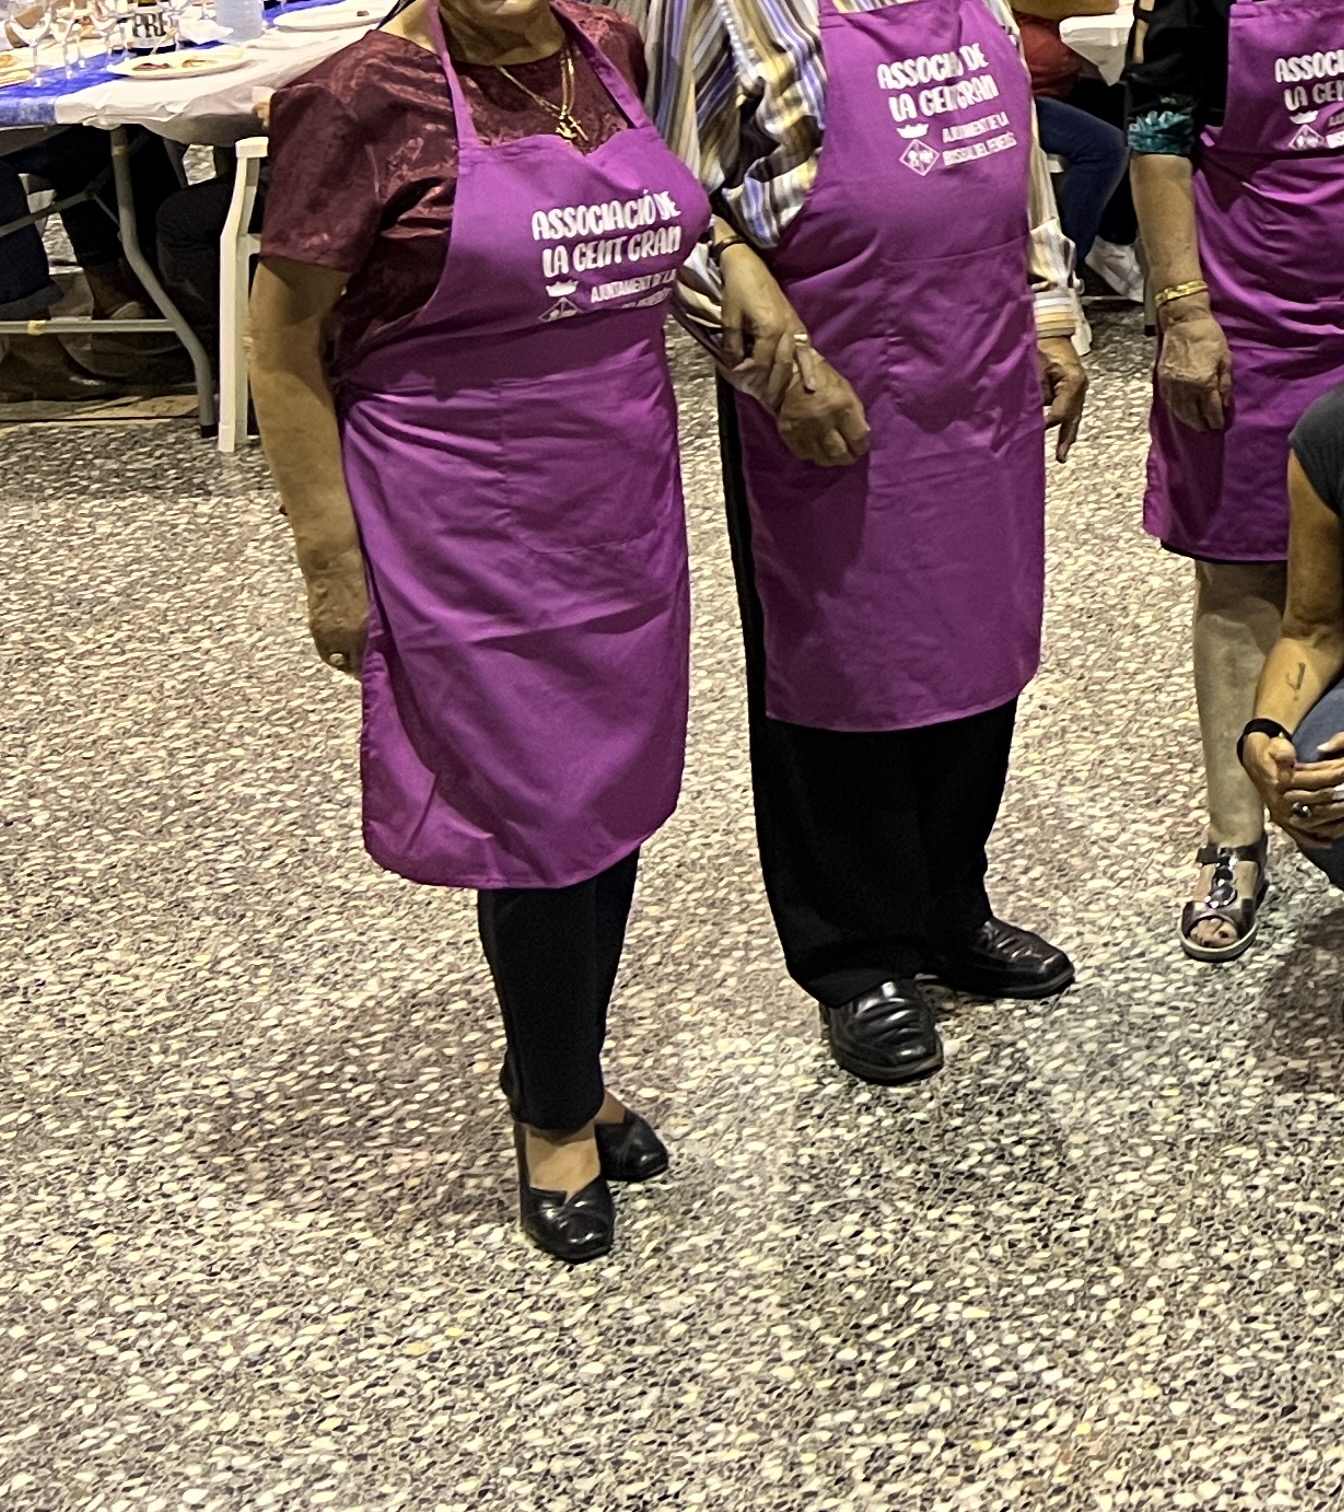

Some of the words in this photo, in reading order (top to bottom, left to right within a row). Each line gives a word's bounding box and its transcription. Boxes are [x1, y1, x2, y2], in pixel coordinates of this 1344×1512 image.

[958, 43, 989, 71] DE
[888, 93, 918, 122] LA
[1284, 86, 1309, 112] LA
[531, 189, 656, 241] ASSOCIACIÓ
[542, 245, 570, 278] LA
[572, 236, 628, 272] GENT
[627, 226, 682, 262] GRAN
